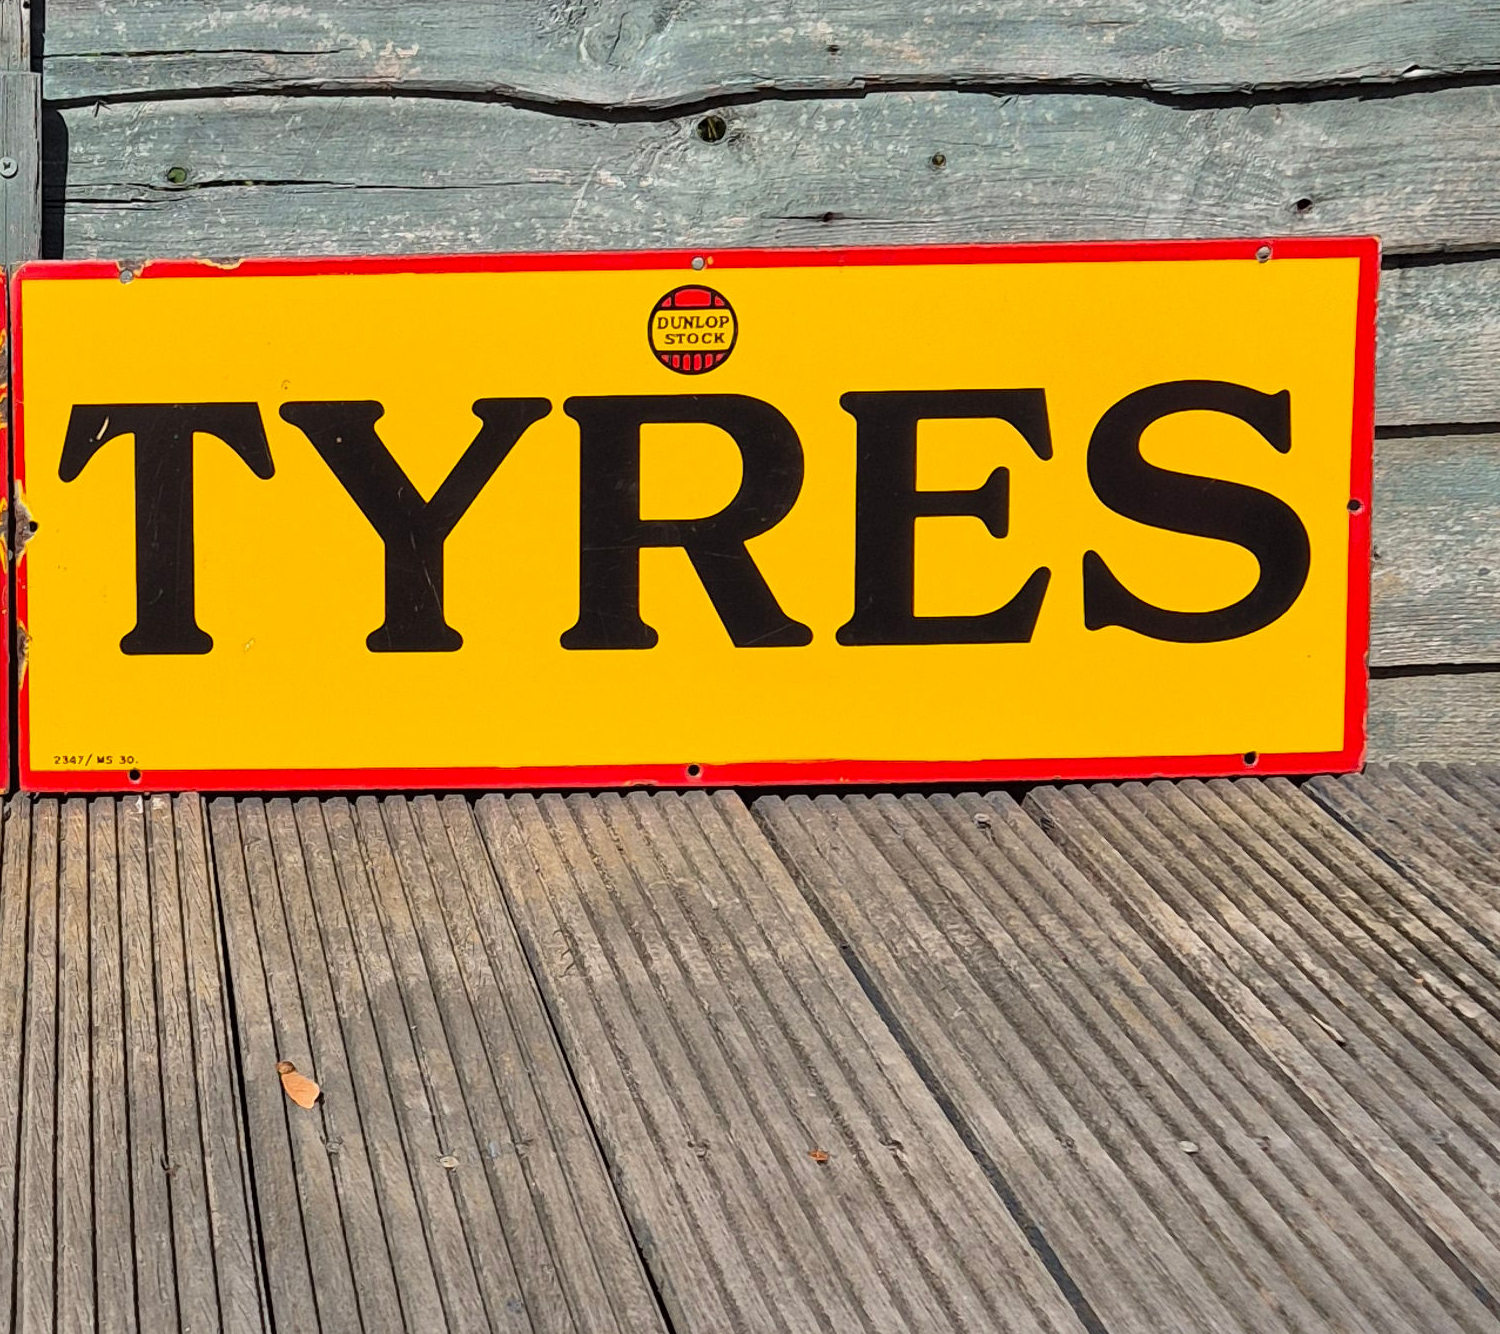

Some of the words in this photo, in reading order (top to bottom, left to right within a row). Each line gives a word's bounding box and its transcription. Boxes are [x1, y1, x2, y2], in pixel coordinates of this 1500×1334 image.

[657, 315, 730, 330] DUNLOP
[664, 332, 725, 345] STOCK
[59, 380, 1311, 655] TYRES
